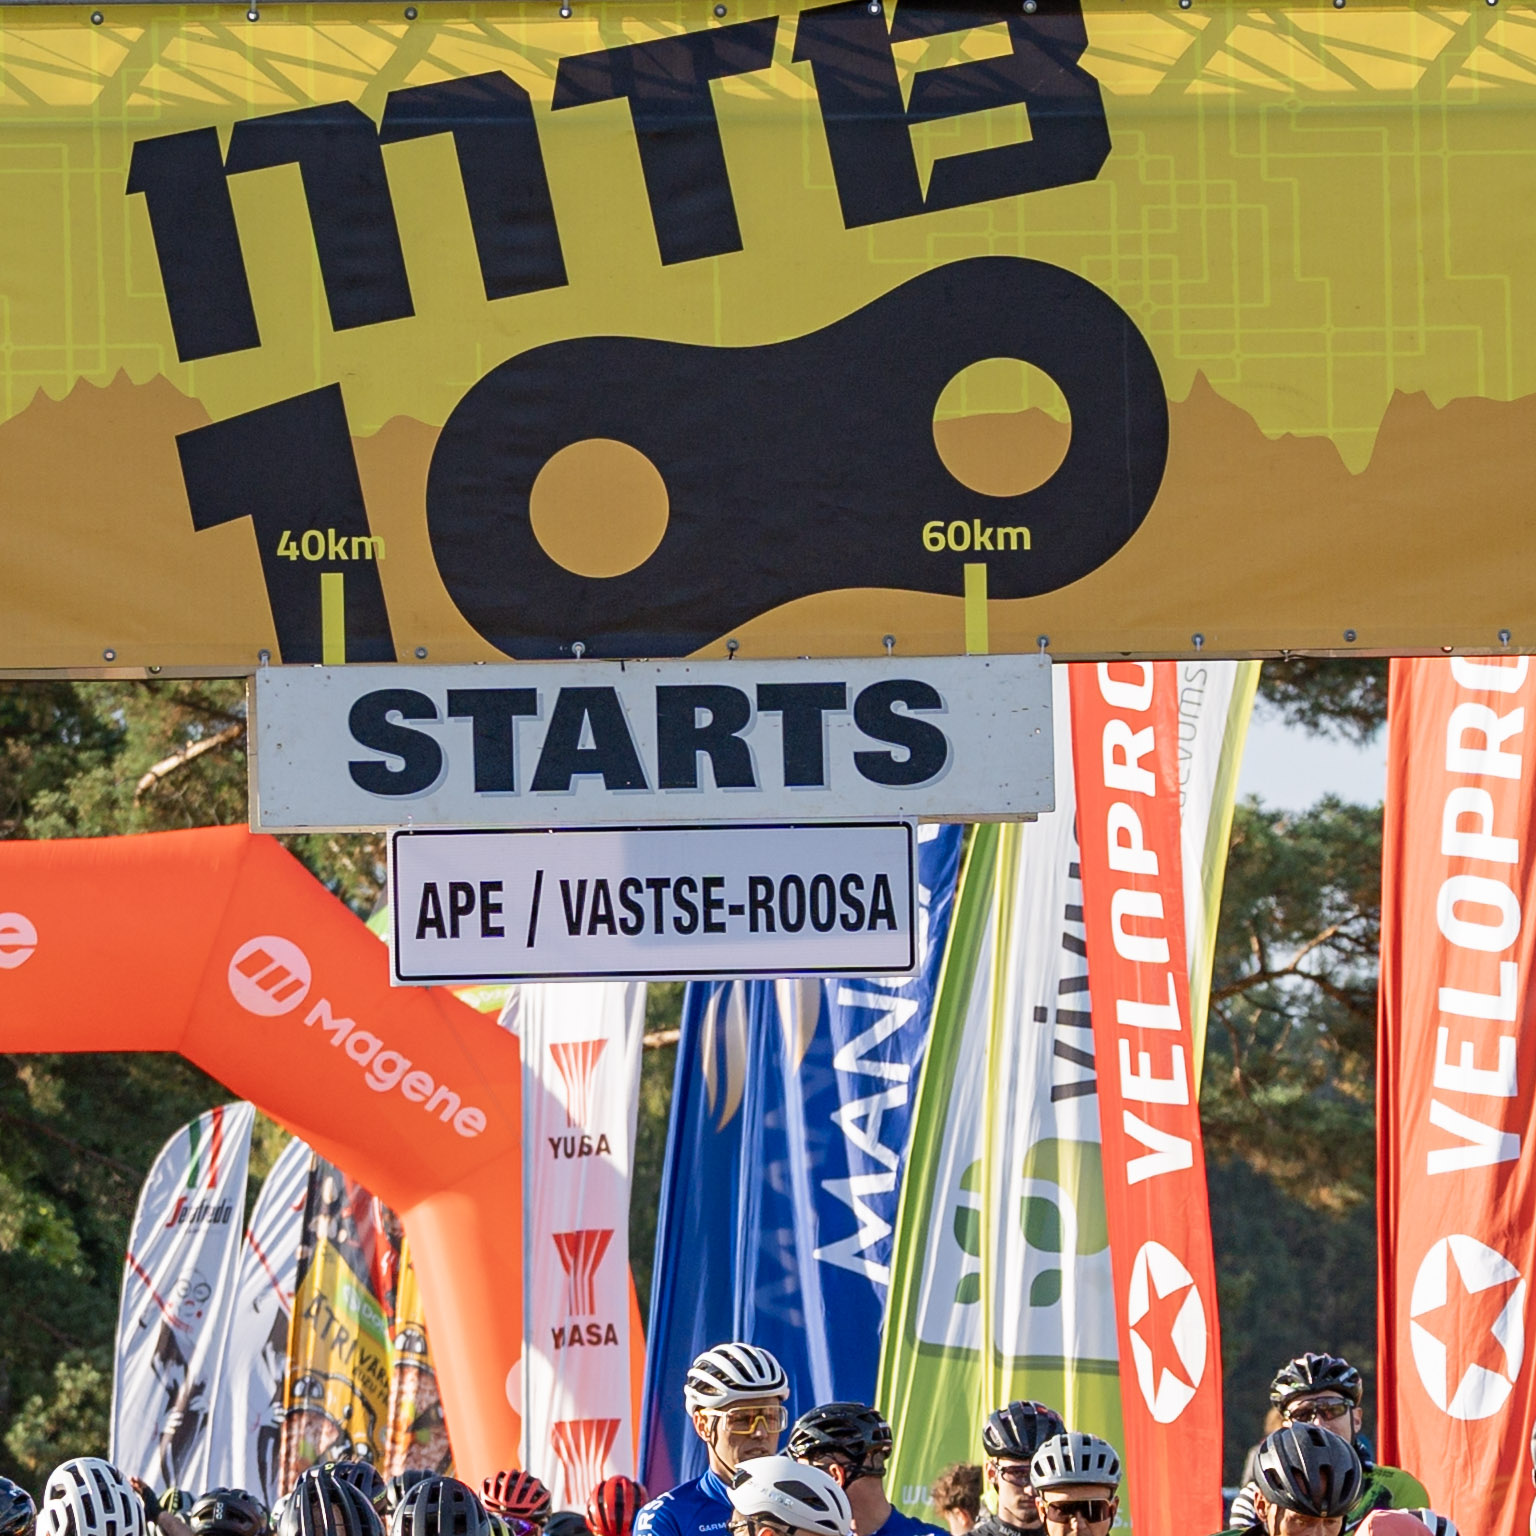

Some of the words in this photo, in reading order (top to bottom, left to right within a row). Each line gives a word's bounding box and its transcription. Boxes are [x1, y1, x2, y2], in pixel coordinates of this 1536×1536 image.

[125, 0, 1112, 363] MTB
[276, 529, 387, 563] 40km
[922, 520, 1031, 552] 60km
[347, 679, 950, 799] STARTS
[415, 879, 505, 942] APE
[527, 869, 545, 949] /
[558, 873, 899, 938] VASTSE-ROOSA
[302, 996, 488, 1138] Magene
[814, 972, 921, 1286] MAN
[699, 1521, 727, 1533] GARM
